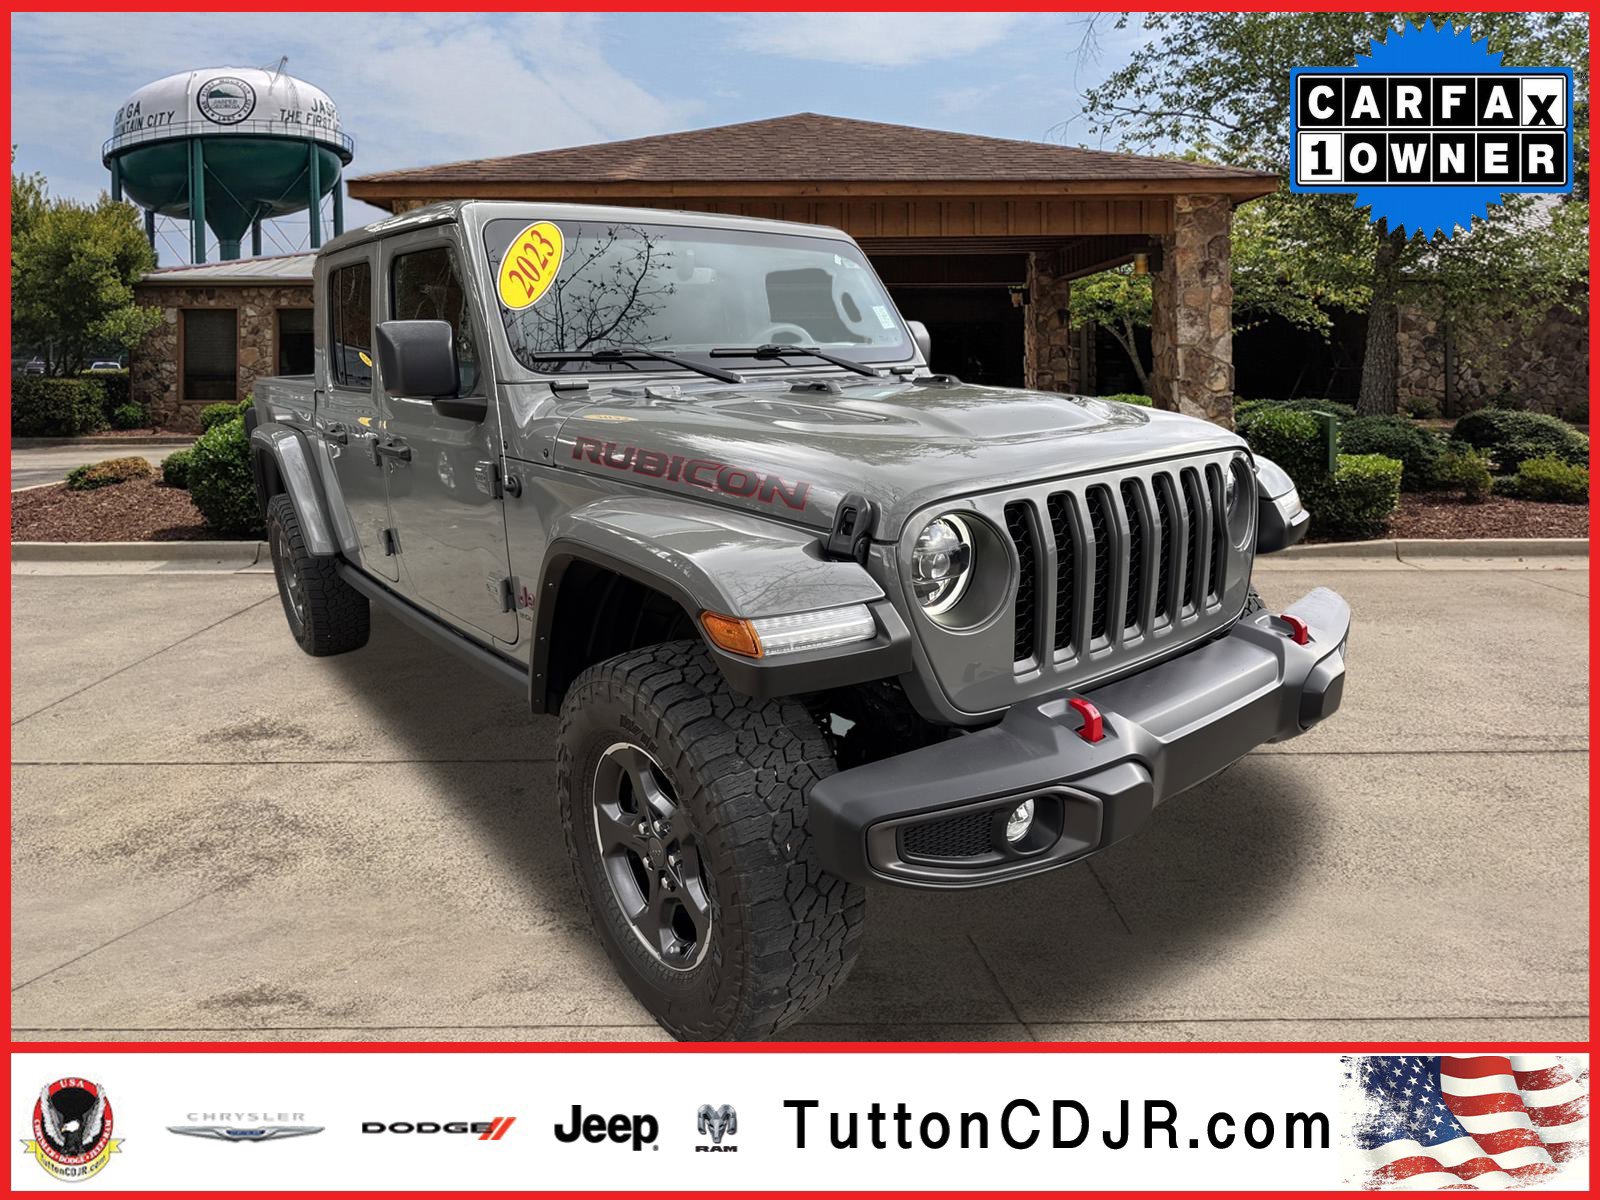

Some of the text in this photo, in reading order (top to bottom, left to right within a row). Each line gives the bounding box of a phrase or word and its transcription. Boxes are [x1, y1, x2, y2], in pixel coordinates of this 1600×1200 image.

[127, 101, 140, 119] GA
[147, 110, 175, 127] CITY
[280, 109, 302, 124] THE
[306, 112, 331, 130] FIRST
[509, 230, 554, 298] 2023
[572, 436, 810, 511] RUBICON
